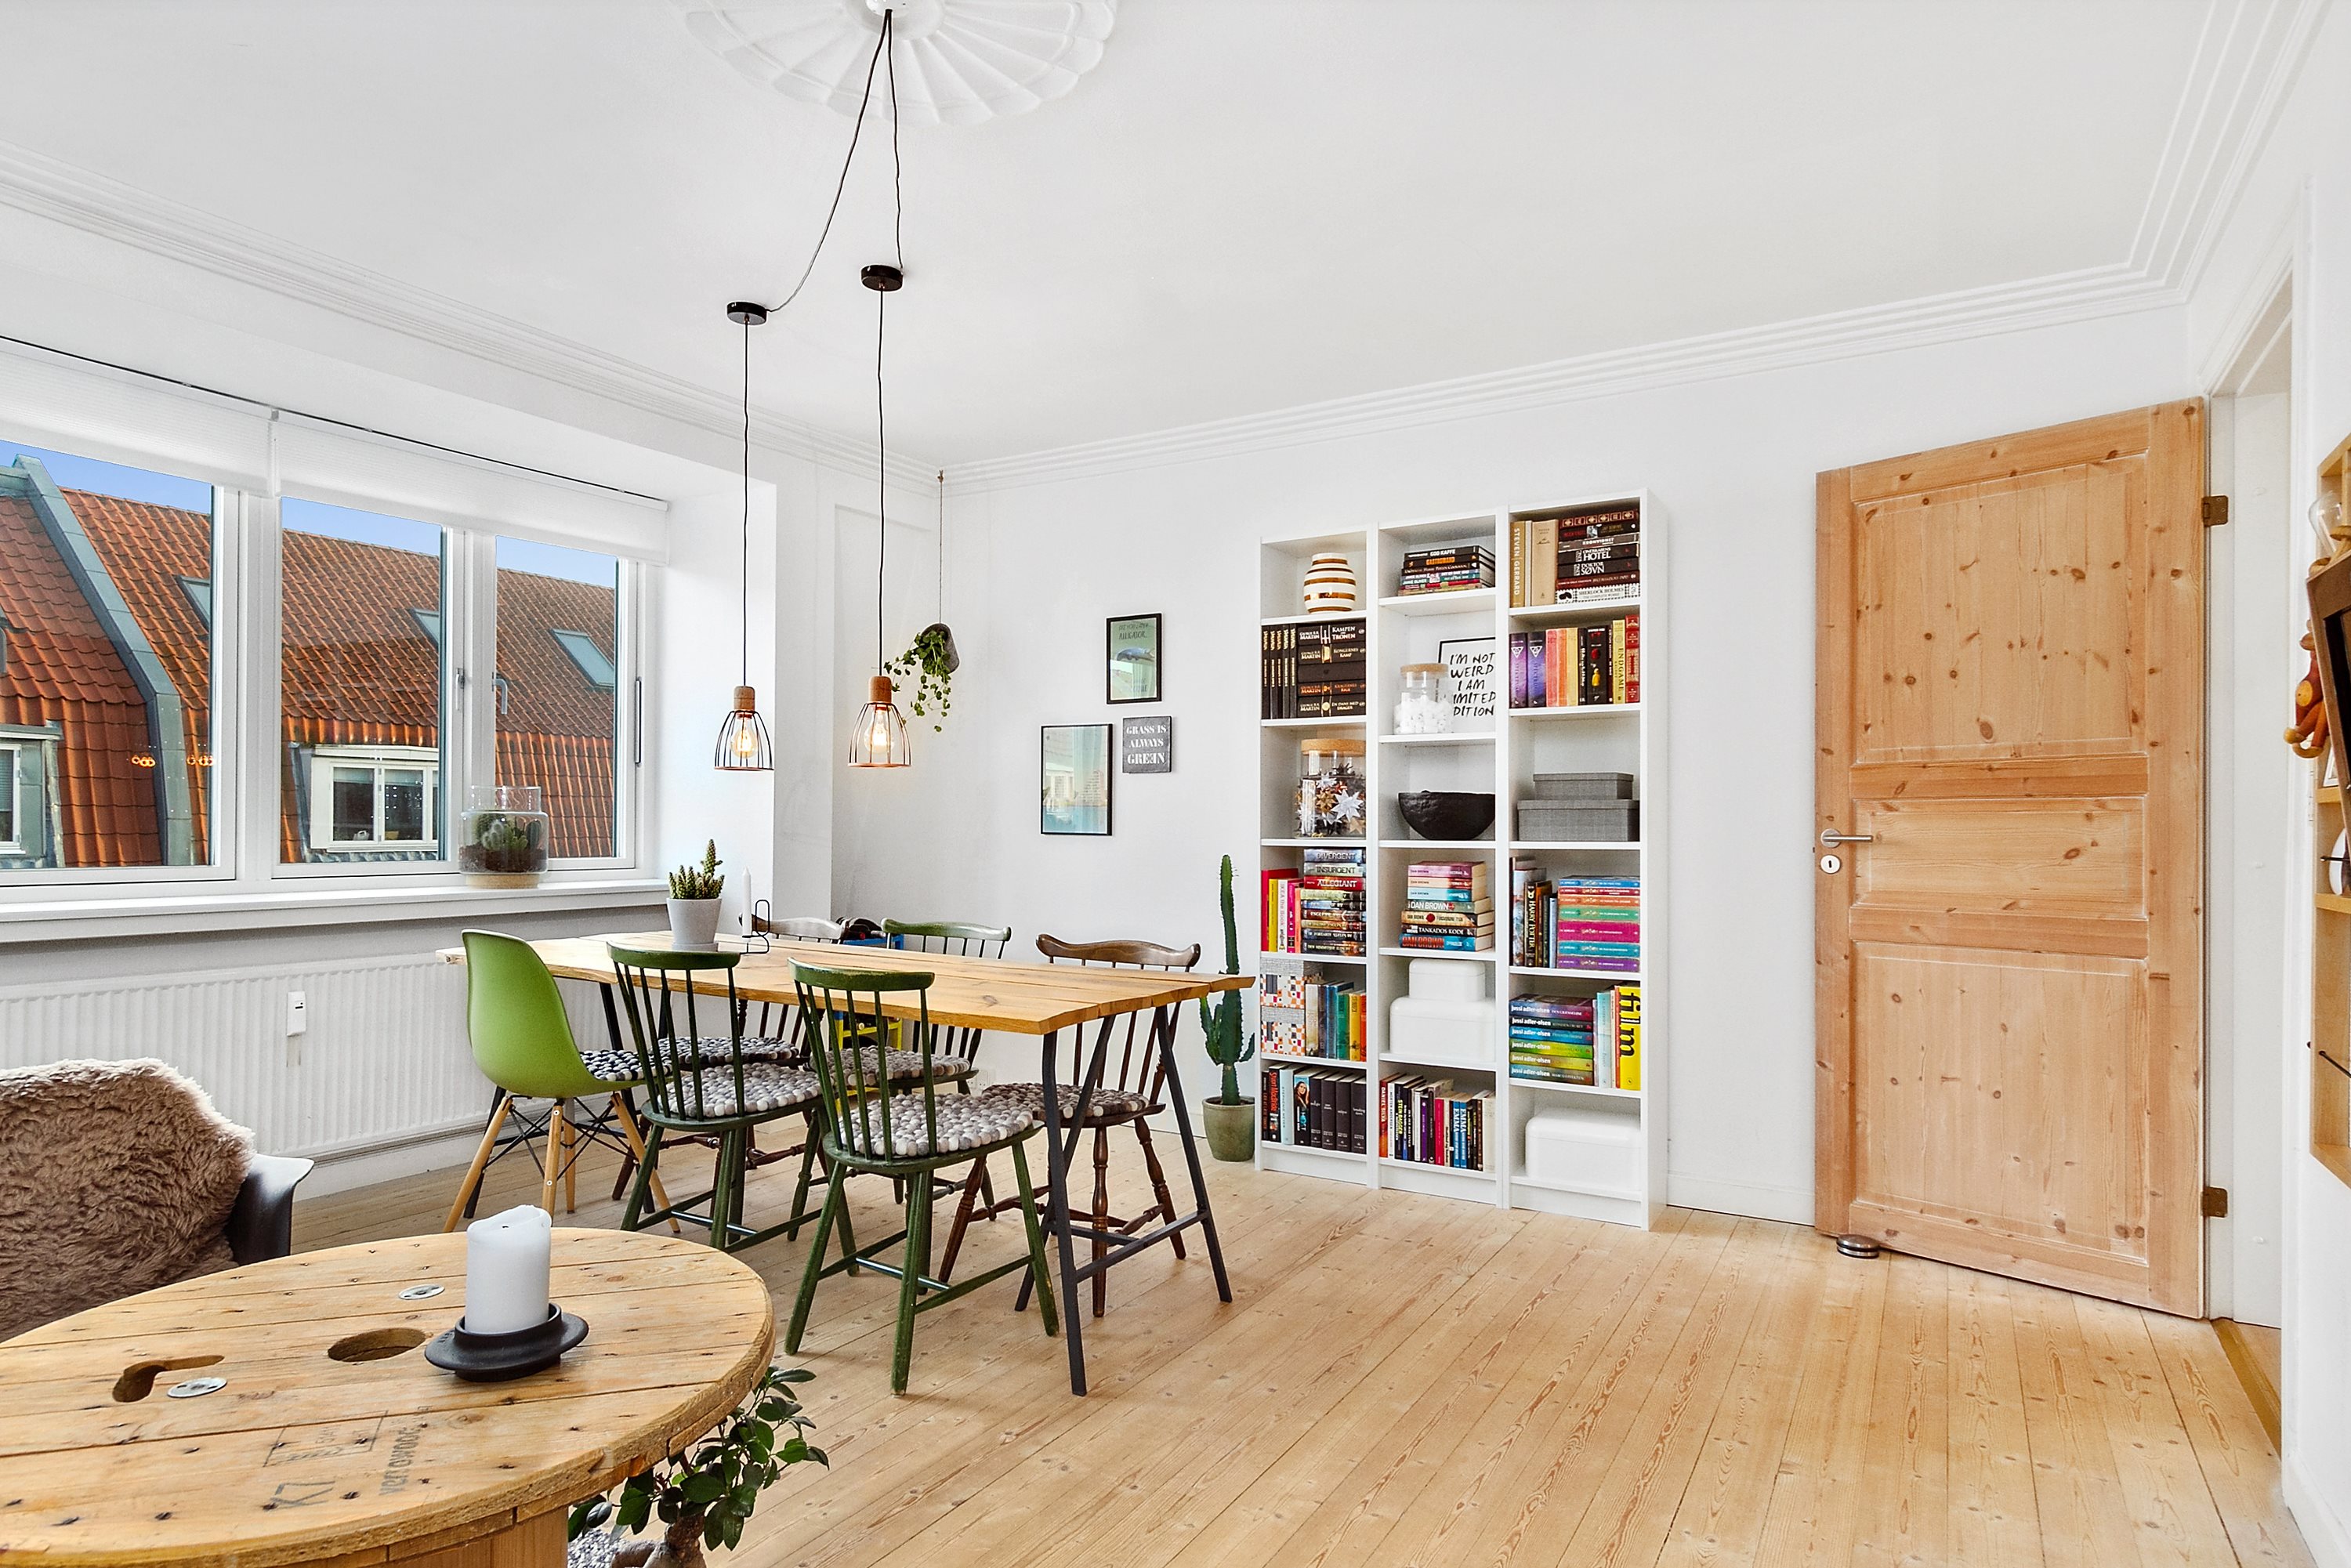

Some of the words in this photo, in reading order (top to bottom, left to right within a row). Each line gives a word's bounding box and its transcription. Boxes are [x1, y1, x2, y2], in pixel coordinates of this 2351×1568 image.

[1583, 551, 1612, 561] HOTEL
[1581, 566, 1605, 575] SØVN
[1450, 654, 1468, 665] I'M
[1473, 653, 1495, 664] NOT
[1451, 664, 1494, 679] WEIRD
[1458, 680, 1462, 691] I
[1465, 679, 1485, 690] AM
[1453, 691, 1496, 704] IMITED
[1454, 704, 1494, 717] DITION
[1126, 725, 1155, 735] GRASS
[1157, 725, 1167, 734] IS
[1128, 738, 1165, 748] ALWAYS
[1127, 752, 1166, 765] GREEN
[1316, 852, 1356, 860] DIVERGENT
[1317, 879, 1357, 888] ALLEGIANT
[1402, 936, 1417, 947] DAN
[1418, 937, 1445, 948] BROWN
[1619, 992, 1641, 1058] film
